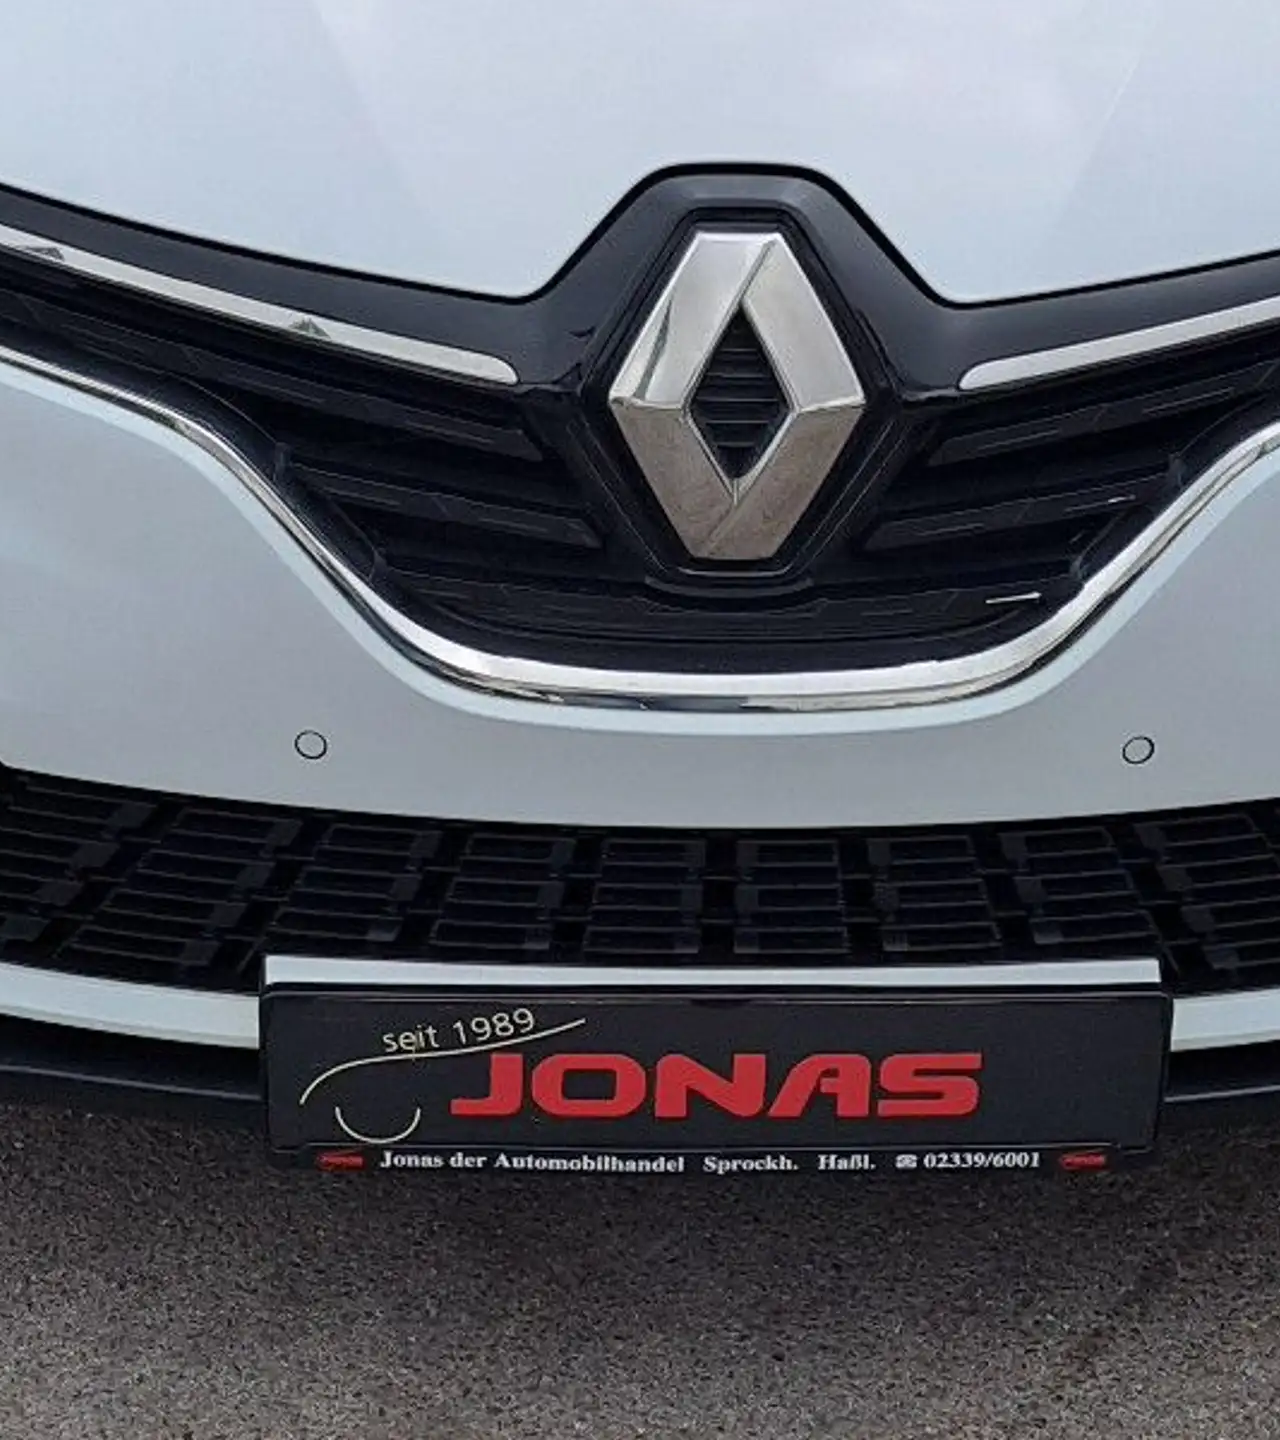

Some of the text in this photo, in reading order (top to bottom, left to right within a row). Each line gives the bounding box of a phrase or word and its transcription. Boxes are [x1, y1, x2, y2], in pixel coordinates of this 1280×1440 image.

[382, 1007, 536, 1053] seit 1989
[450, 1053, 982, 1118] JONAS
[380, 1151, 443, 1169] Jonas
[450, 1152, 487, 1168] der
[494, 1153, 685, 1172] Automobilhandel
[703, 1156, 799, 1175] Sprockh.
[923, 1152, 1041, 1169] 02339/6001
